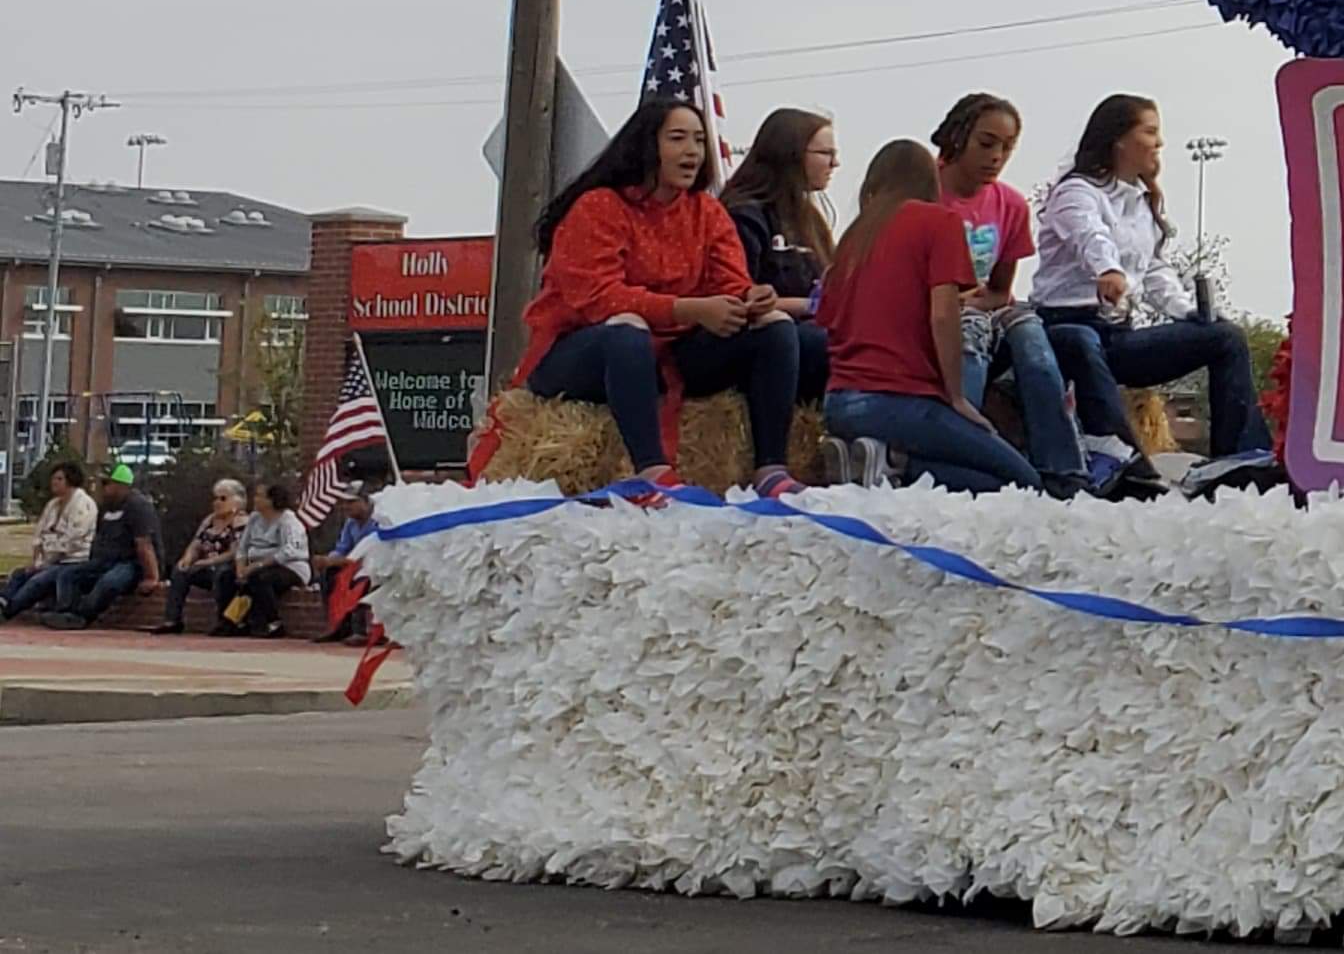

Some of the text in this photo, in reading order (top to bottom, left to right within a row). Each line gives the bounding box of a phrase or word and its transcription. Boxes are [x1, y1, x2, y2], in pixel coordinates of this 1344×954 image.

[402, 251, 450, 278] Holly
[352, 290, 488, 319] School Distric
[375, 370, 450, 391] Welcome
[390, 391, 465, 410] Home of
[413, 409, 473, 430] Wildca
